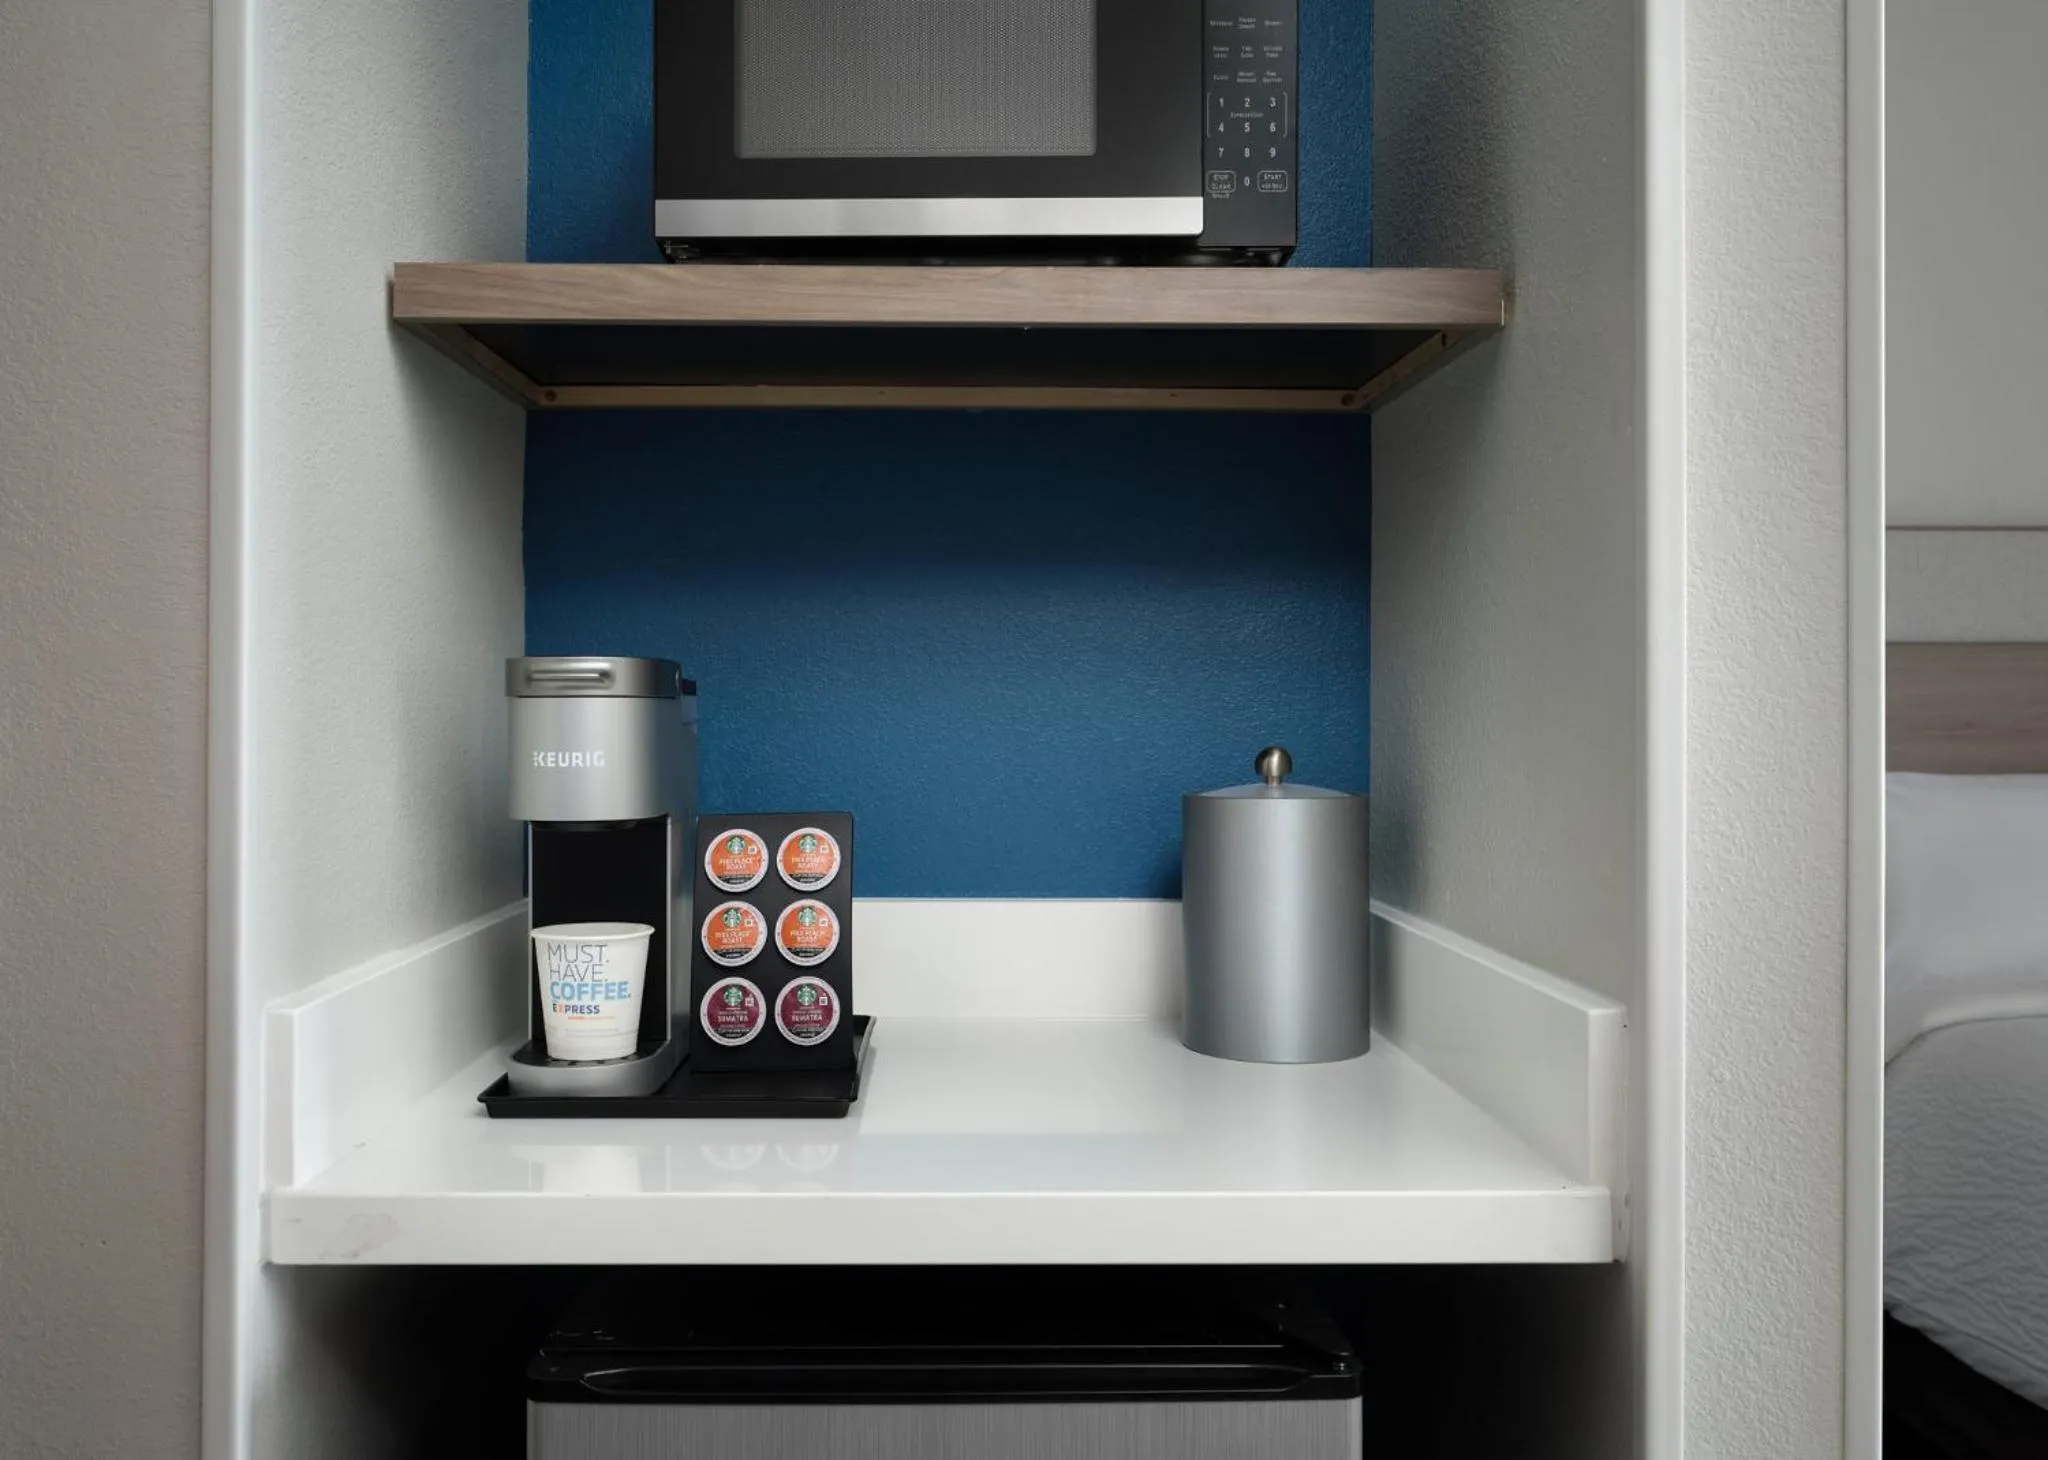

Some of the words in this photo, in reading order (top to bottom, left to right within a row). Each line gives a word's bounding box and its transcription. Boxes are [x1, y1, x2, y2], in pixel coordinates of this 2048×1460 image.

[1219, 97, 1224, 108] 1
[1244, 97, 1251, 108] 2
[1270, 97, 1276, 108] 3
[1218, 122, 1224, 132] 4
[1244, 122, 1250, 132] 5
[1269, 122, 1276, 132] 6
[1218, 147, 1224, 158] 7
[1244, 147, 1250, 158] 8
[1269, 147, 1276, 158] 9
[532, 751, 606, 768] KEURIG
[547, 942, 609, 963] MUST.
[549, 964, 608, 982] HAVE.
[550, 981, 631, 1001] COFFEE.
